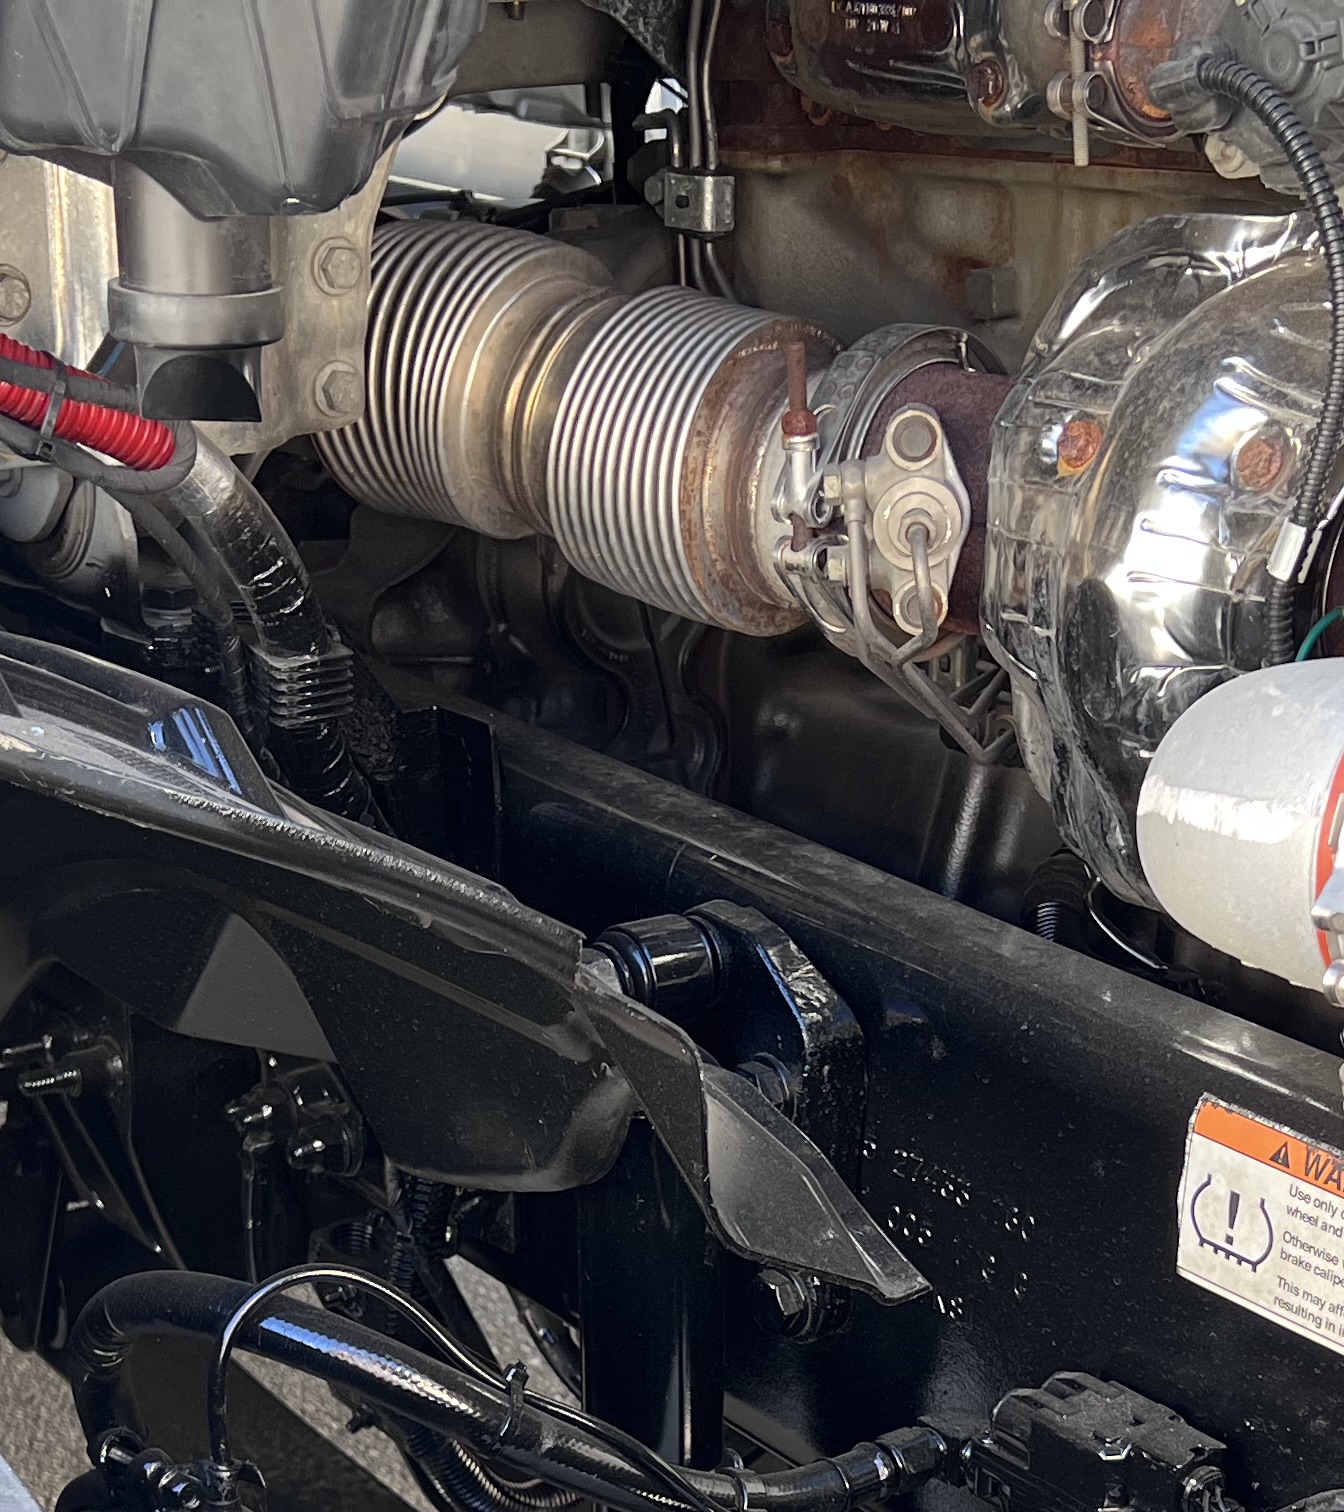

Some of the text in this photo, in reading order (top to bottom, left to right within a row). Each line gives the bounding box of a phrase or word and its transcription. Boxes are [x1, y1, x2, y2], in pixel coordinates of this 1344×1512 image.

[1288, 1184, 1312, 1204] Use
[1313, 1197, 1339, 1218] only
[1285, 1204, 1319, 1228] wheel
[1320, 1217, 1344, 1238] and
[1279, 1247, 1313, 1273] brake
[1282, 1230, 1340, 1266] Otherwise
[1276, 1274, 1301, 1297] This
[1301, 1288, 1327, 1311] may
[1272, 1293, 1323, 1330] resulting
[1324, 1314, 1337, 1334] in
